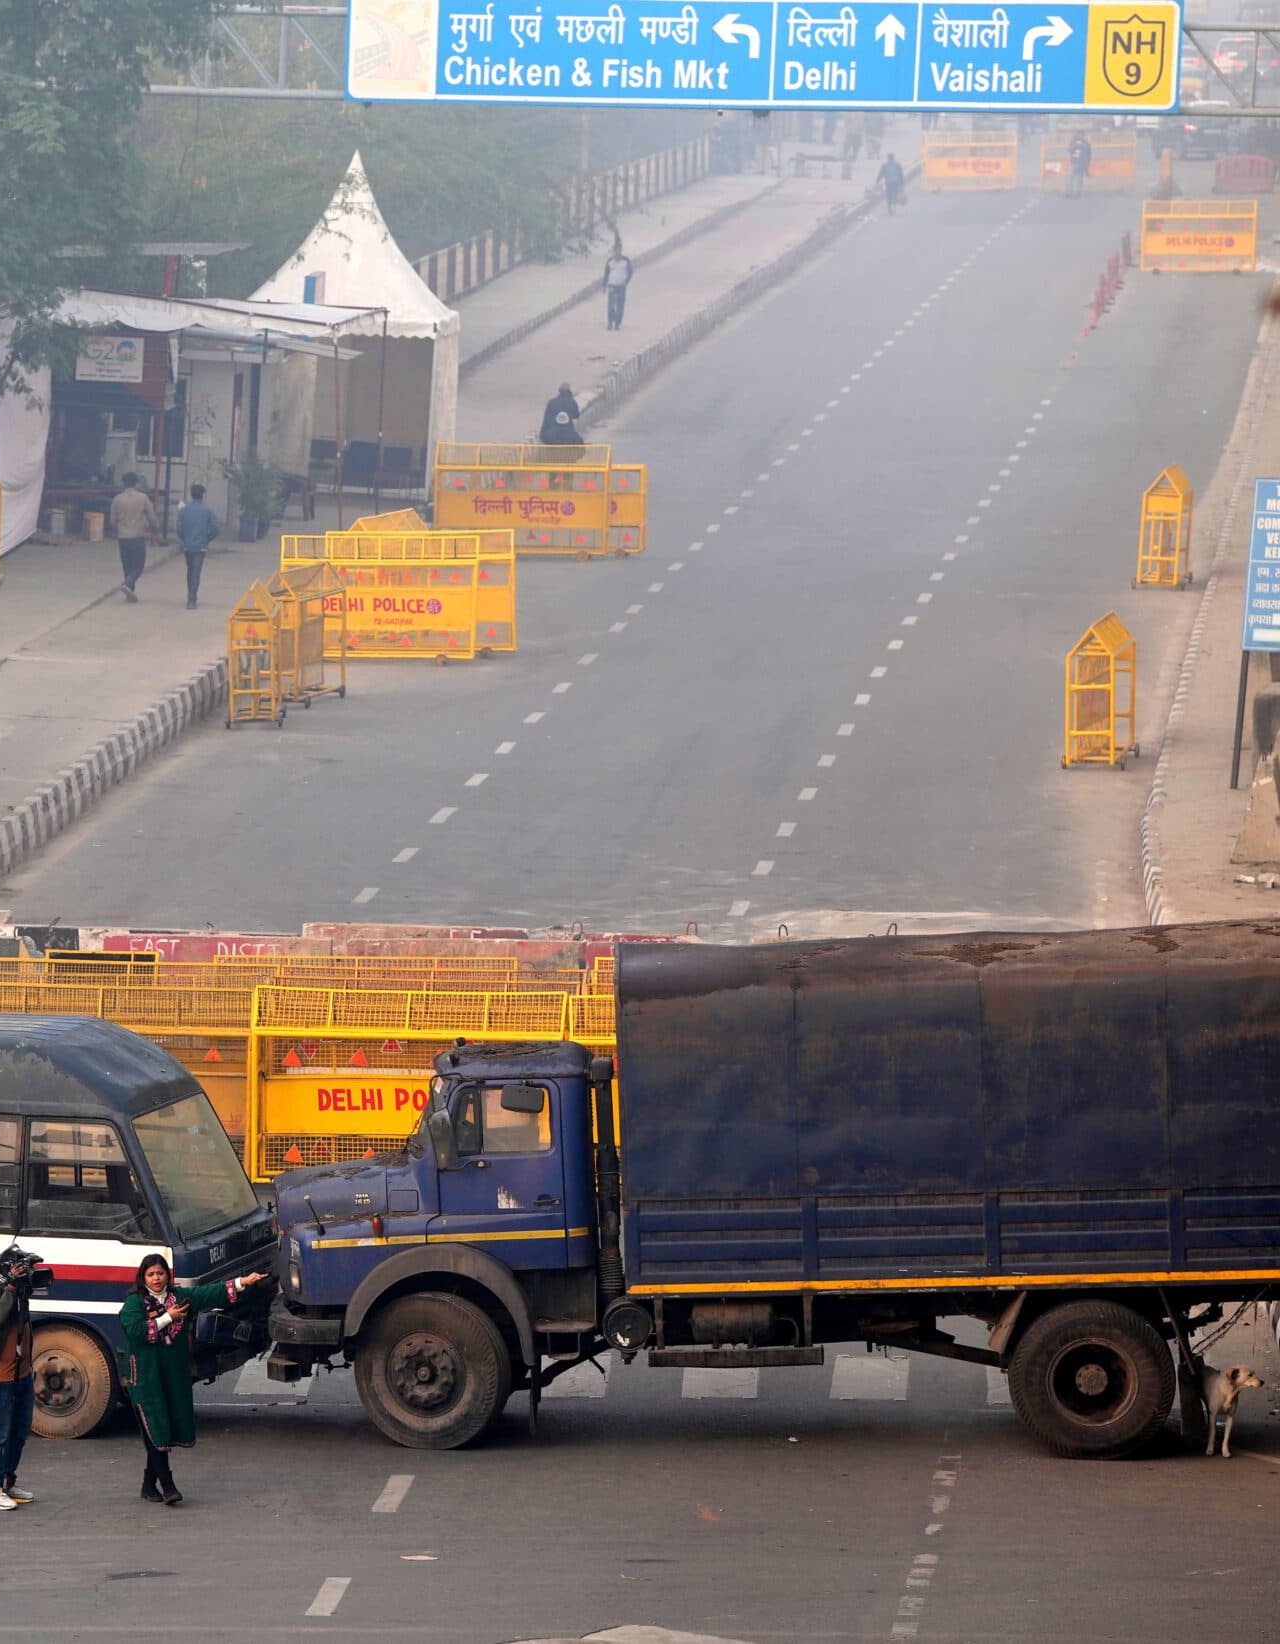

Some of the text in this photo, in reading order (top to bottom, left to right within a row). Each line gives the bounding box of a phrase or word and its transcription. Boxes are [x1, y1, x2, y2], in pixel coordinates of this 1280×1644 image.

[449, 3, 699, 53] मुर्गा एवं मछली मण्डी
[787, 7, 858, 47] दिल्ली
[932, 8, 1010, 49] वैशाली
[1111, 31, 1157, 55] NH
[444, 56, 729, 90] Chicken & Fish Mkt
[783, 61, 856, 91] Delhi
[931, 62, 1042, 93] Vaishali
[1125, 63, 1142, 86] 9
[472, 496, 513, 514] दिल्ली
[518, 496, 561, 519] पुलिस
[373, 598, 426, 614] POLICE
[317, 1088, 383, 1111] DELHI
